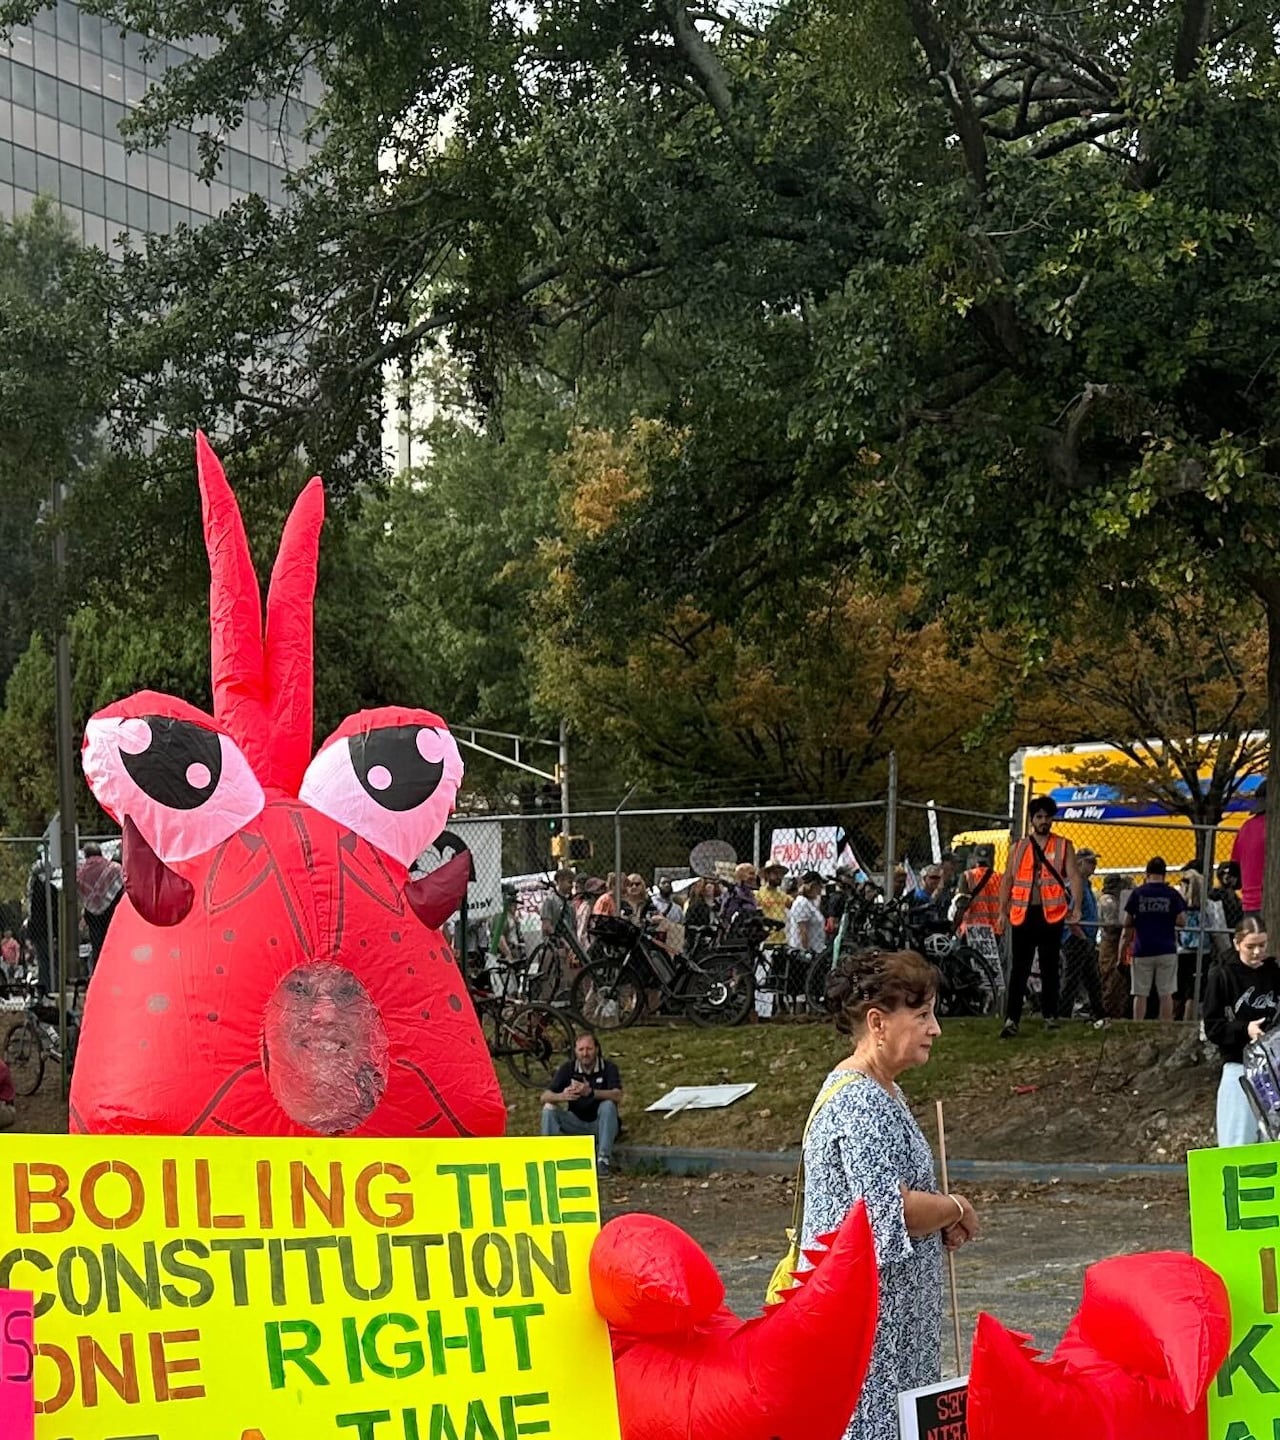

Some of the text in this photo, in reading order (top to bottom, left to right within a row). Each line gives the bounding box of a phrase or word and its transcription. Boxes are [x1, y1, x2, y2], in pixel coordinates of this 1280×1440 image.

[1084, 805, 1106, 820] Way
[794, 829, 817, 843] NO
[13, 1157, 598, 1235] BOILING THE
[32, 1303, 546, 1416] ONE RIGHT
